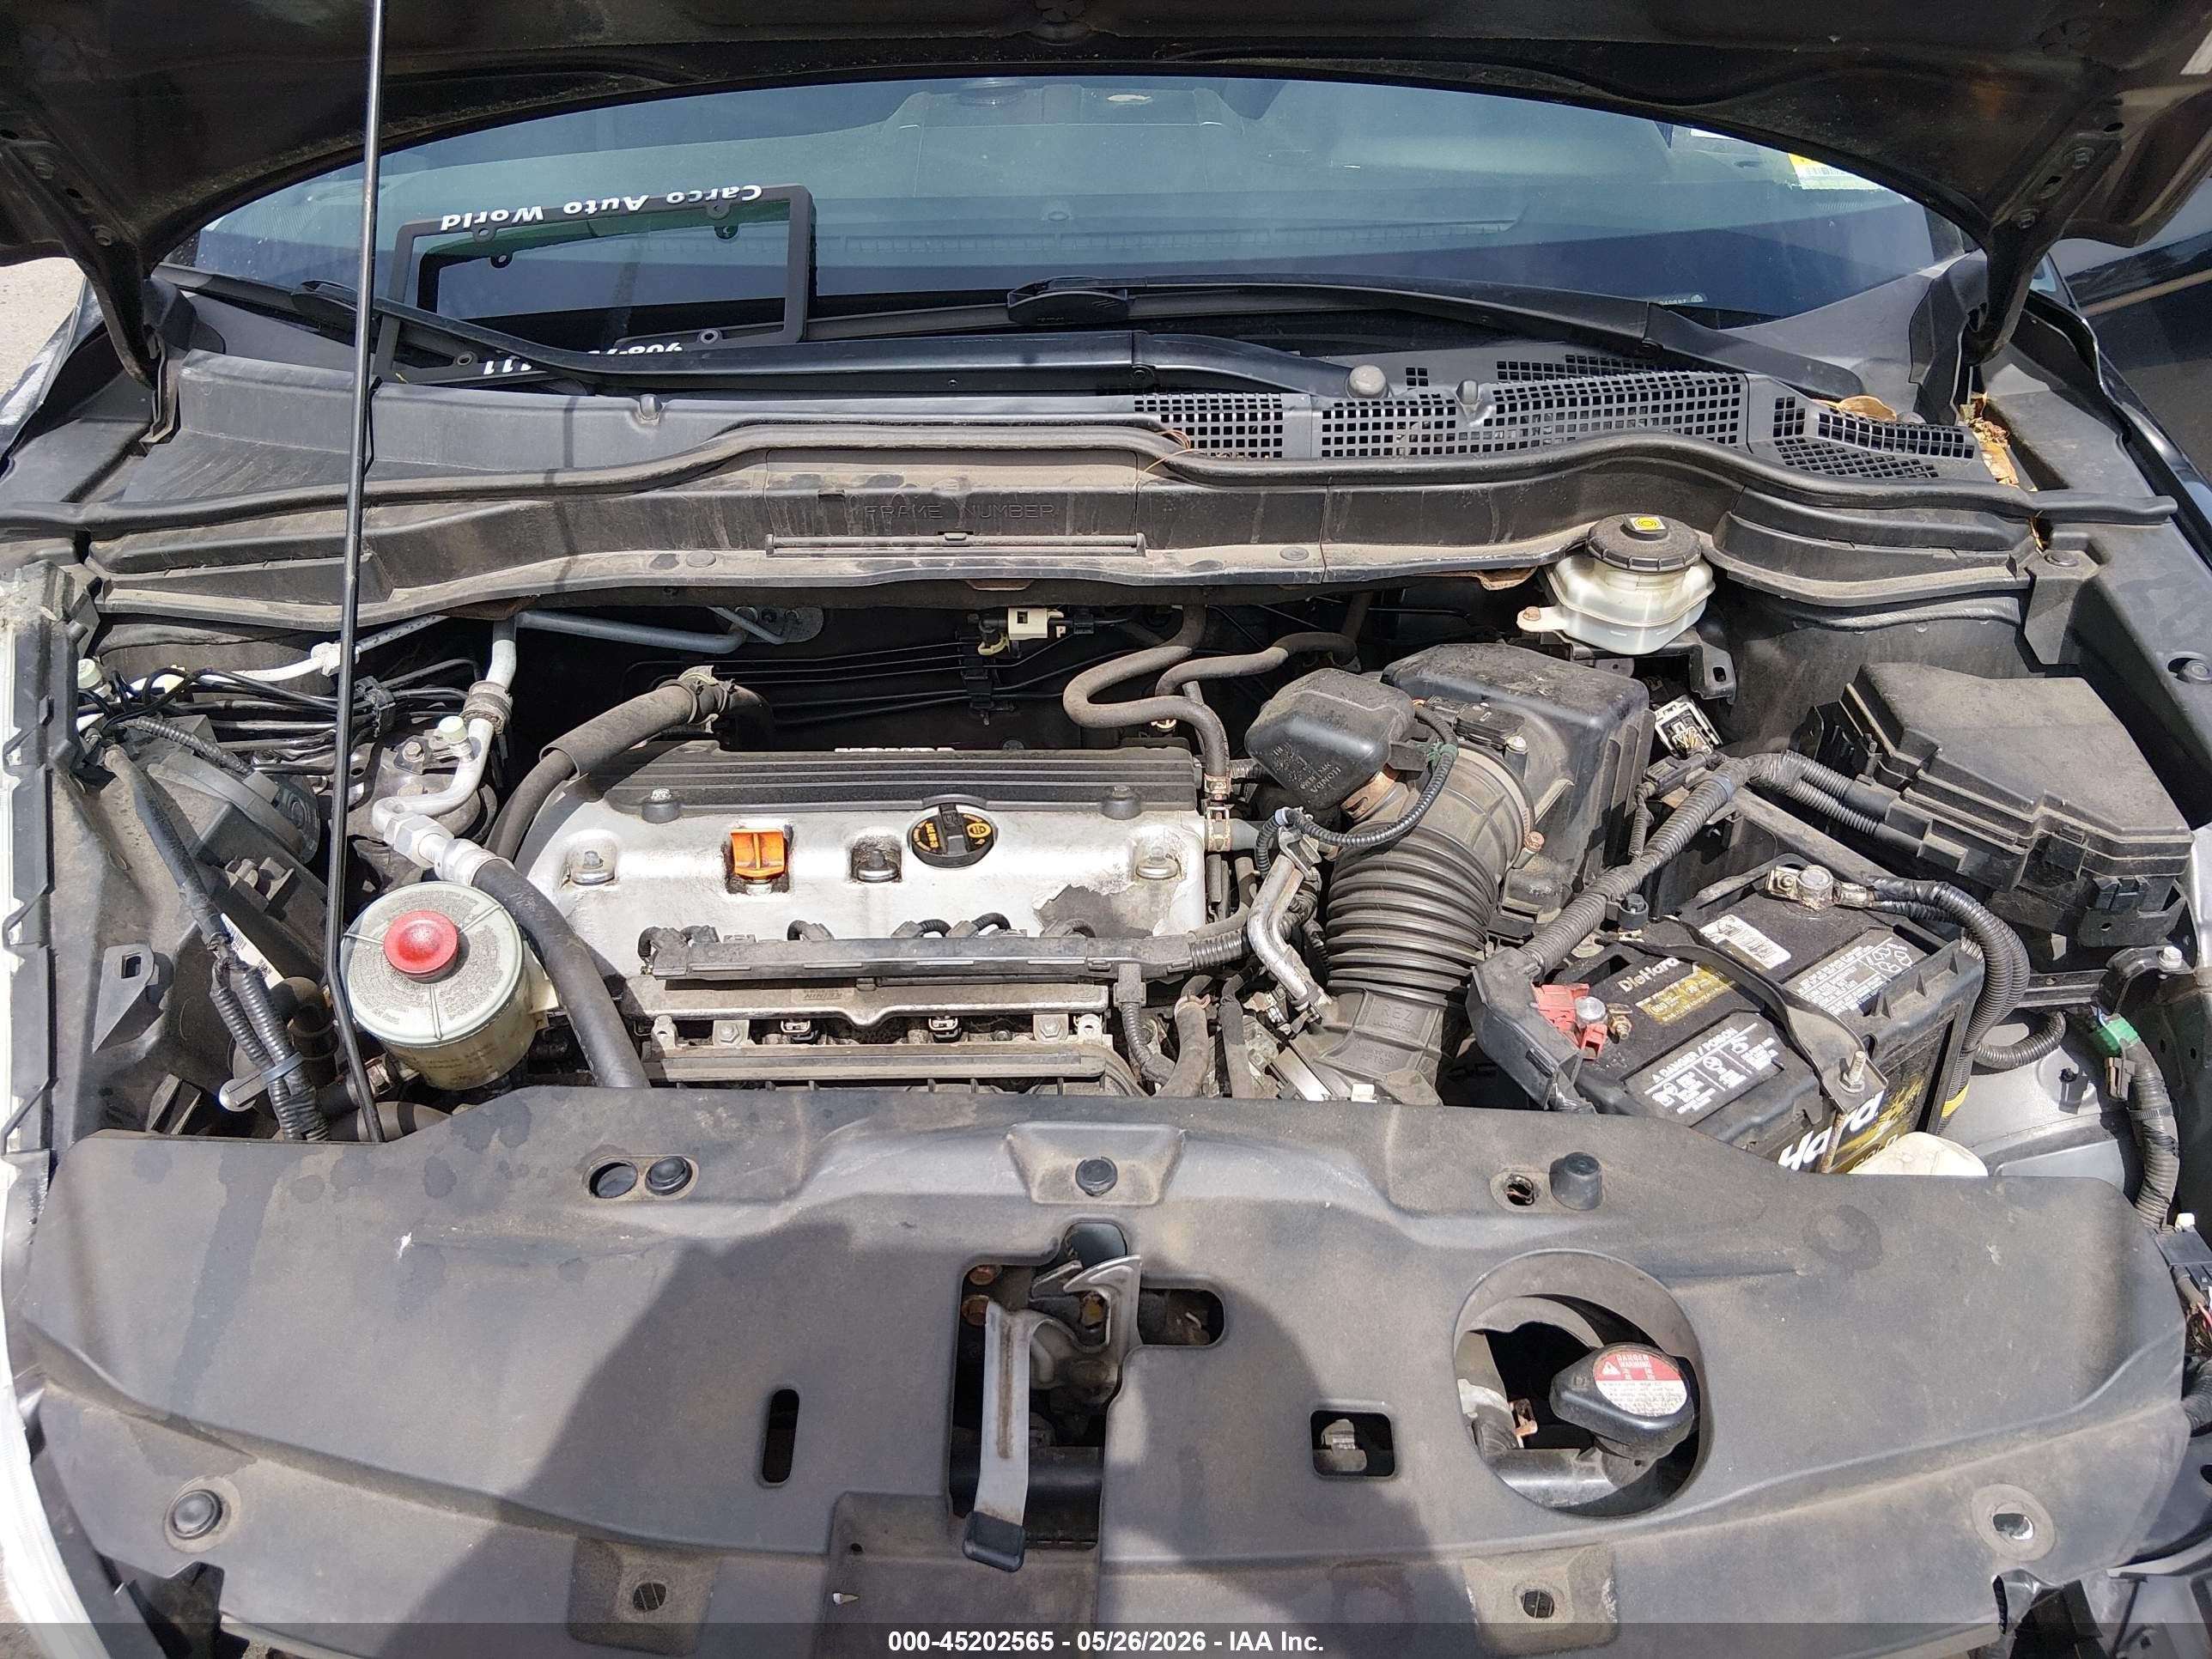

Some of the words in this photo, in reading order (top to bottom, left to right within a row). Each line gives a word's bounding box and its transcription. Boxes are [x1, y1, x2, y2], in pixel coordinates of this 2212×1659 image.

[562, 194, 650, 216] Auto
[665, 184, 763, 205] Carco
[440, 205, 545, 231] World
[864, 504, 944, 520] FRAME
[960, 504, 1056, 520] NUMBER
[1310, 766, 1342, 793] HONDA
[1658, 1051, 1700, 1078] DANGER
[1701, 1026, 1739, 1051] POISON
